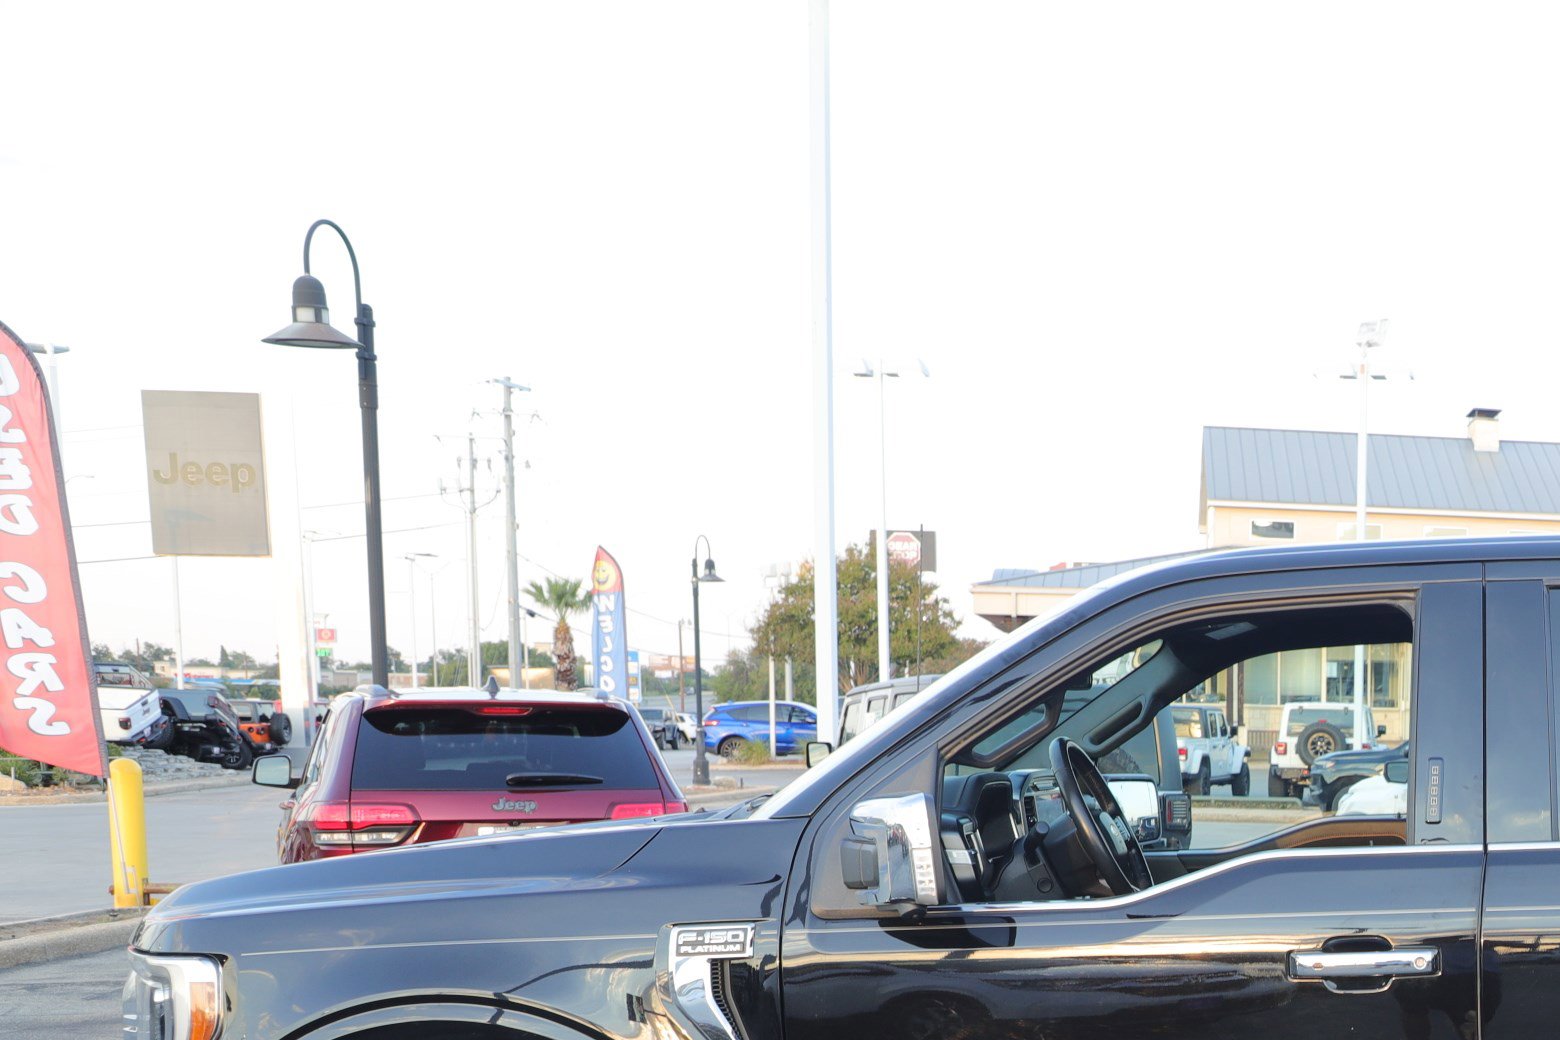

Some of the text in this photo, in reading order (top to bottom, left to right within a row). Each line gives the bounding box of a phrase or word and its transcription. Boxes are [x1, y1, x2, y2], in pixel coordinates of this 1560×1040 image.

[152, 452, 257, 494] Jeep
[492, 797, 537, 814] Jeep
[678, 930, 745, 945] F-150
[680, 944, 740, 954] PLATINUM
